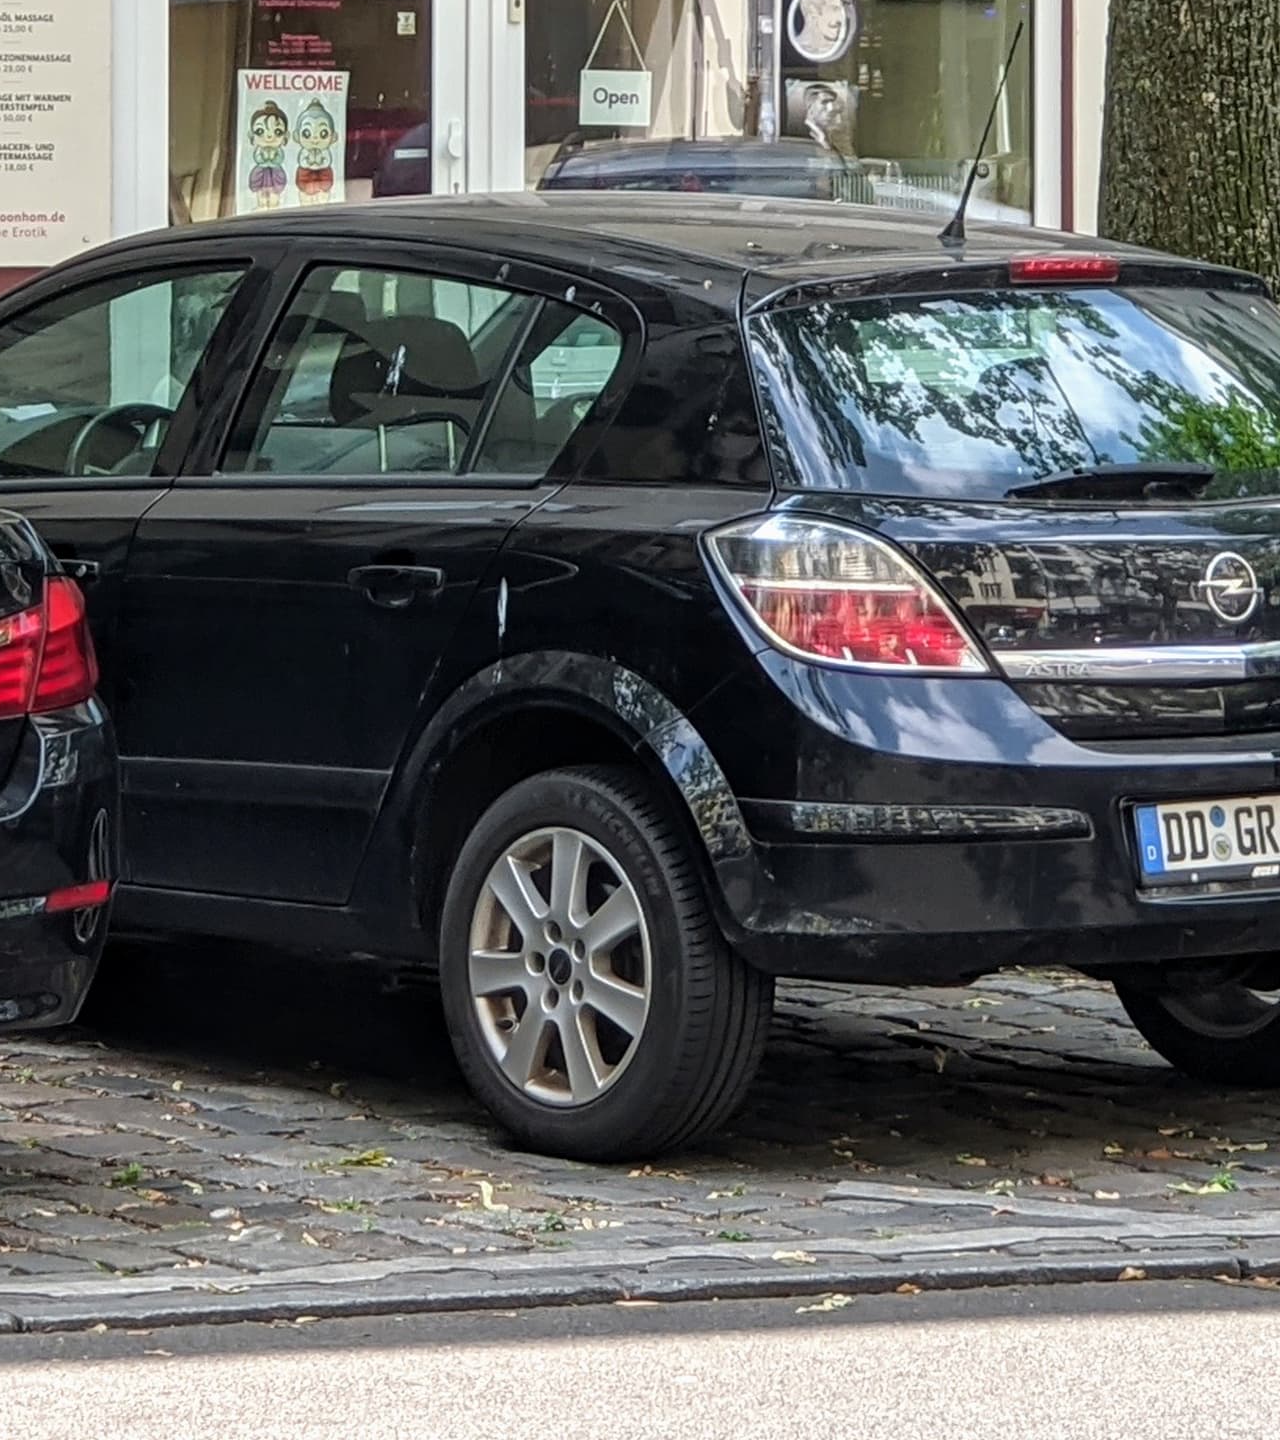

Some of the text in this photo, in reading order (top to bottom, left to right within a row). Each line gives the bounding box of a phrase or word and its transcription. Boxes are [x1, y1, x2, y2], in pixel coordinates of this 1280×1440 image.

[15, 13, 55, 23] MASSAGE
[245, 73, 343, 91] WELLCOME
[592, 87, 640, 110] Open
[34, 143, 55, 152] UND
[12, 226, 48, 239] Erotik
[1025, 661, 1091, 677] ASTRA
[1147, 845, 1157, 861] D
[1162, 810, 1209, 863] DD
[1233, 804, 1280, 857] GR
